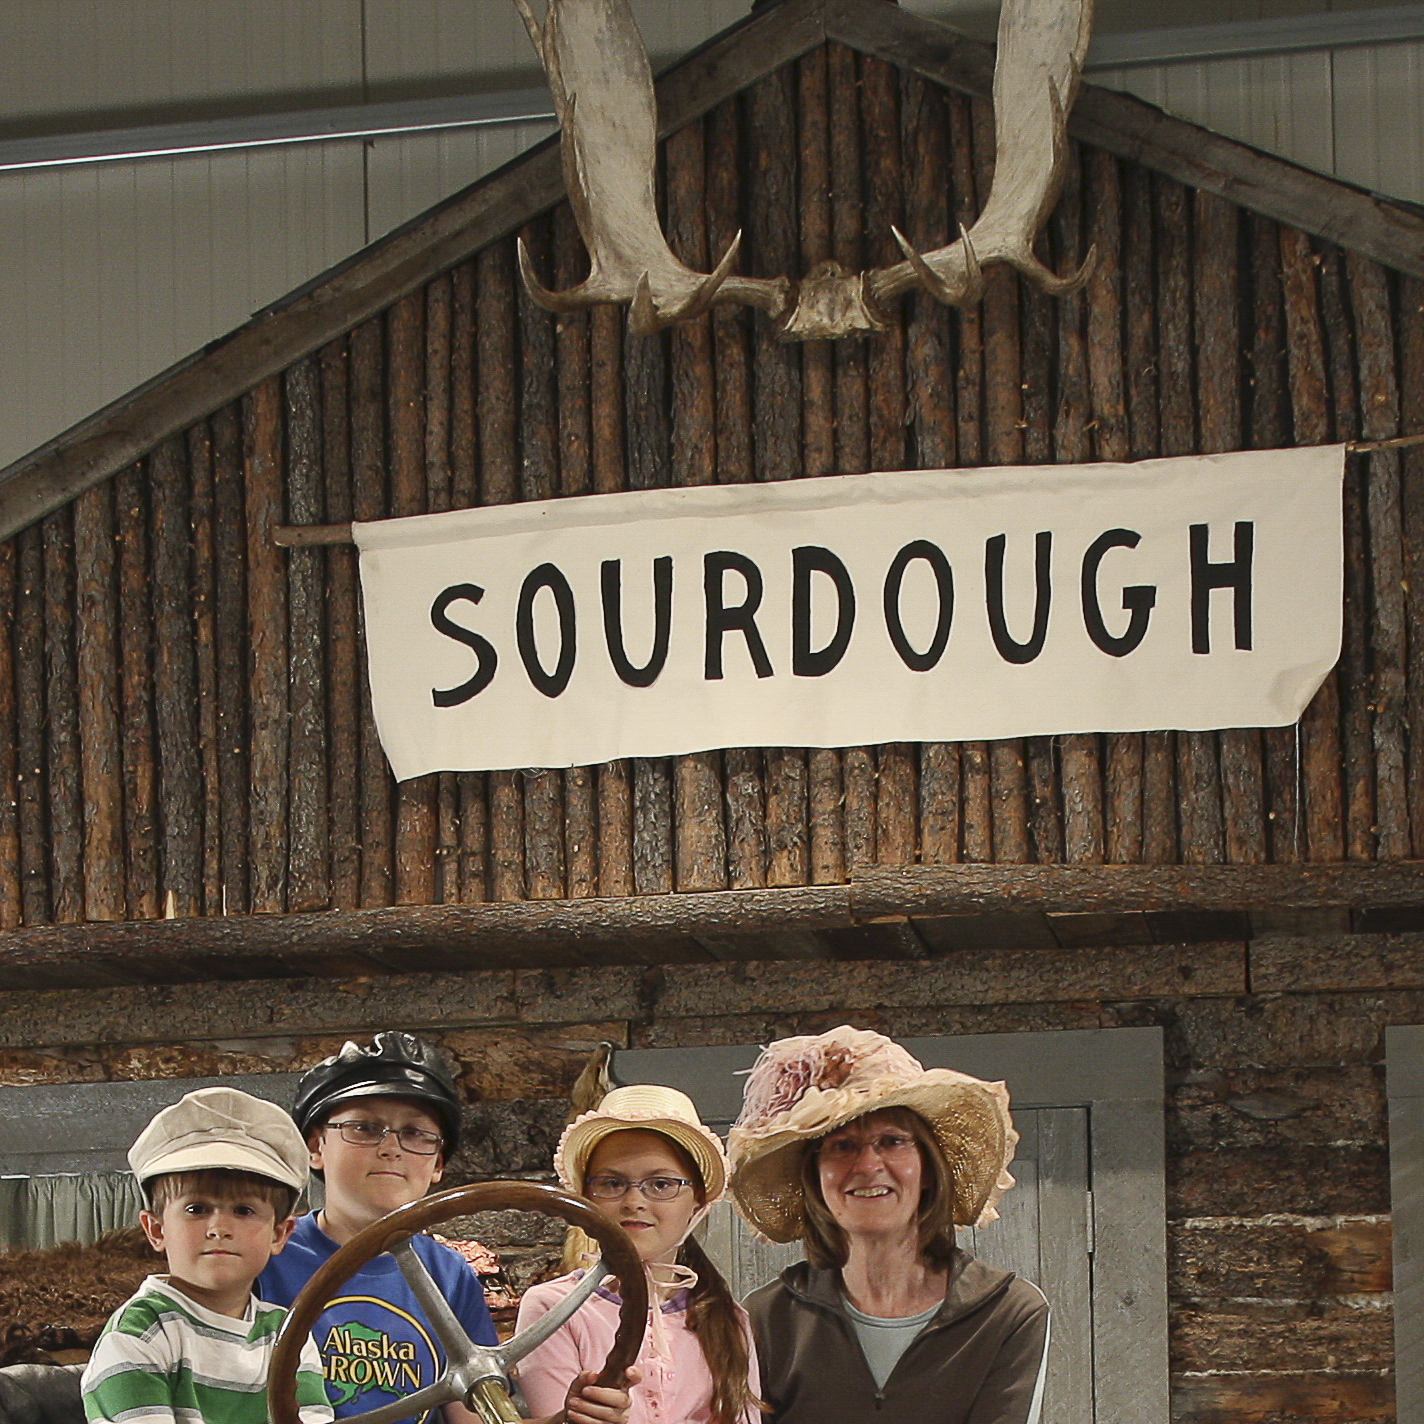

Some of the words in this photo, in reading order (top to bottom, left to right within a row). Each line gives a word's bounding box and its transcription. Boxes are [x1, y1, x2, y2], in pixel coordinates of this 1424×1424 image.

[430, 520, 1255, 708] SOURDOUGH
[322, 1326, 417, 1361] Alaska
[320, 1352, 422, 1389] ROWN
